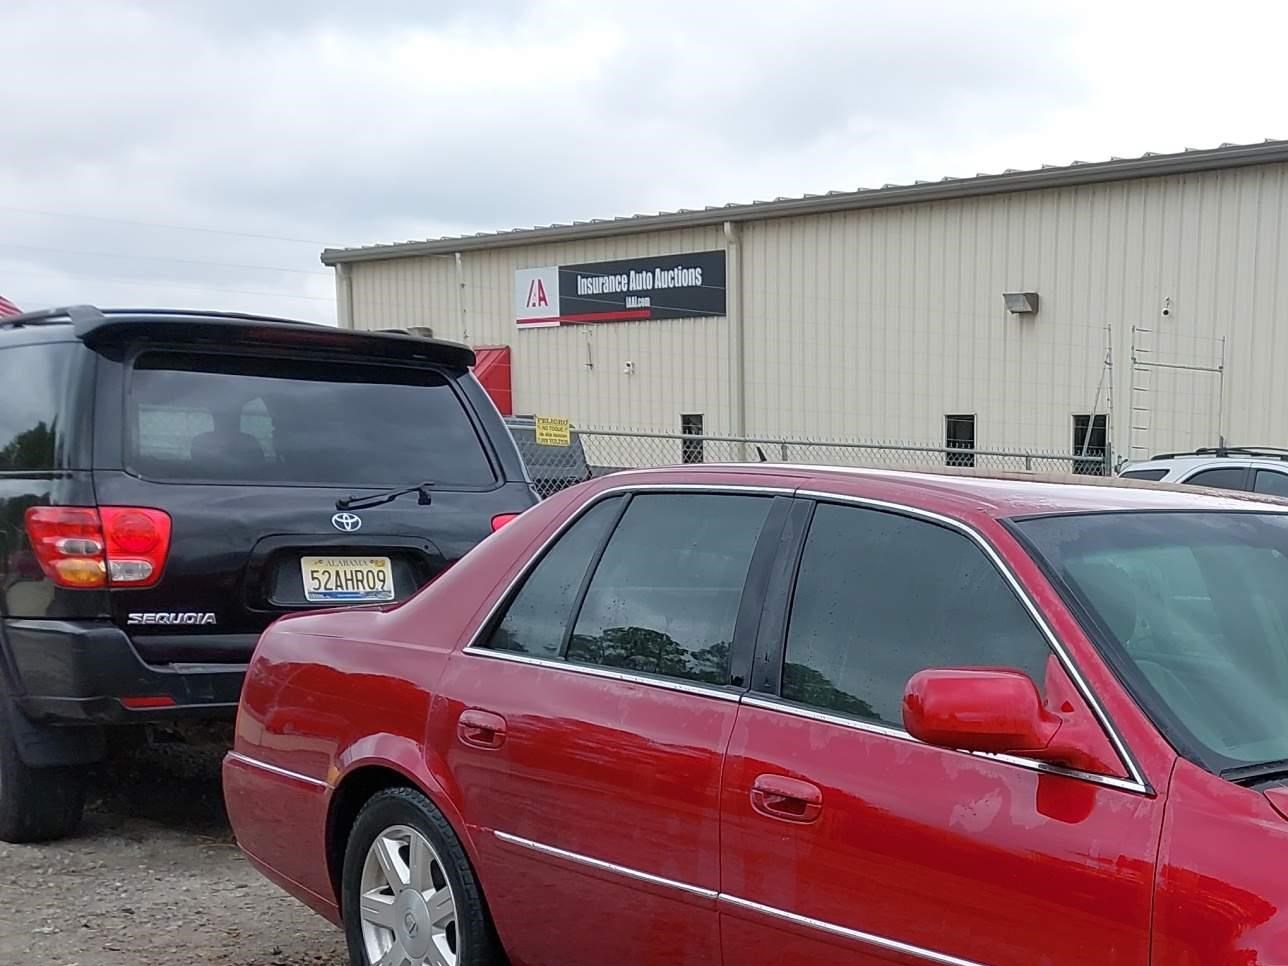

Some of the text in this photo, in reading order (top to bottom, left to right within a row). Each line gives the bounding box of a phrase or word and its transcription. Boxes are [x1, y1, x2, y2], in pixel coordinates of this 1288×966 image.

[577, 266, 702, 295] Insurance Auto Auctions
[326, 559, 374, 567] ALABAMA
[311, 569, 386, 591] 52AHR09
[127, 612, 216, 625] SEQUOIA
